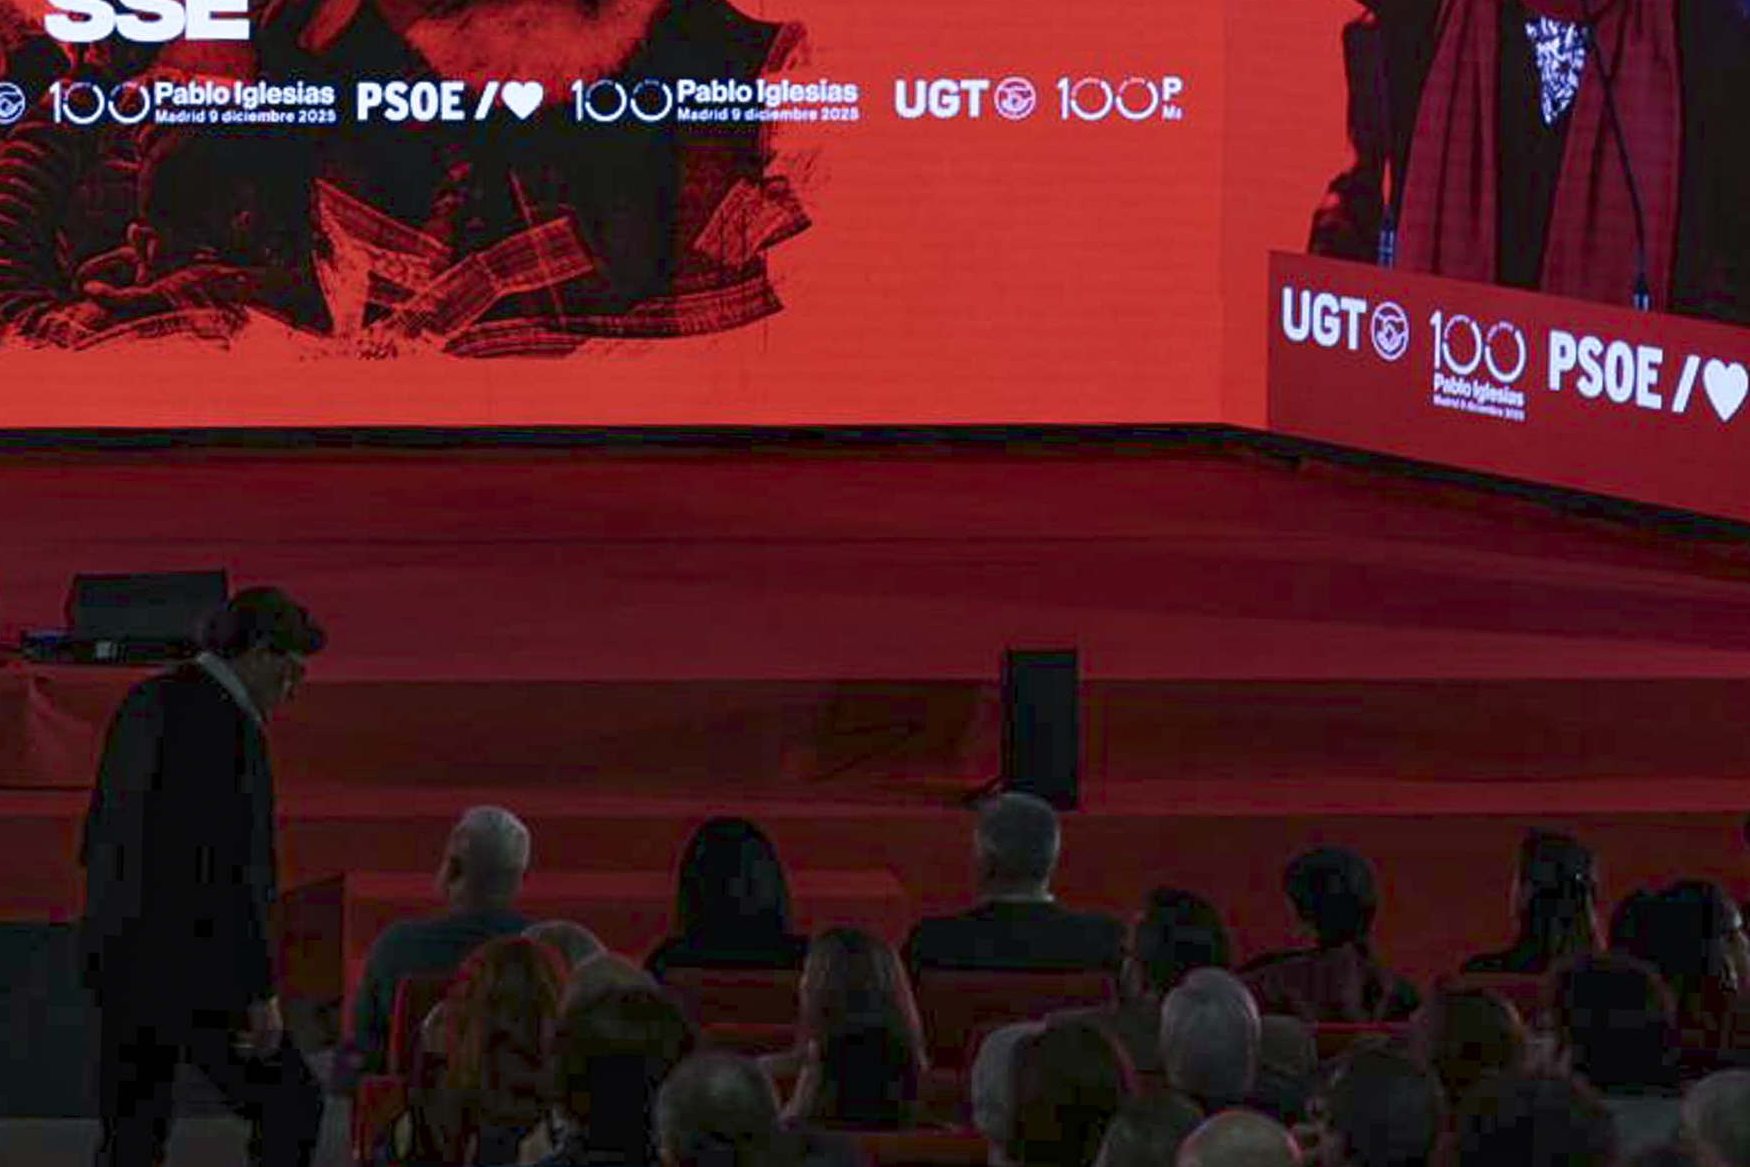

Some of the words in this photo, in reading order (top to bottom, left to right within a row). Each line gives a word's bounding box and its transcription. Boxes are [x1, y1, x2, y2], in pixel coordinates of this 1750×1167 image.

[49, 81, 151, 125] 100
[154, 81, 231, 106] Pablo
[234, 80, 336, 110] Iglesias
[357, 81, 466, 122] PSOE
[571, 79, 673, 122] 100
[677, 79, 753, 103] Pablo
[757, 79, 859, 107] Iglesias
[894, 79, 990, 119] UGT
[1056, 77, 1159, 120] 100
[155, 109, 206, 124] Madrid
[221, 109, 296, 124] diciembre
[298, 109, 337, 124] 2025
[677, 107, 728, 122] Madrid
[1282, 287, 1367, 350] UGT
[1430, 310, 1526, 383] 100
[1548, 329, 1663, 410] PSOE
